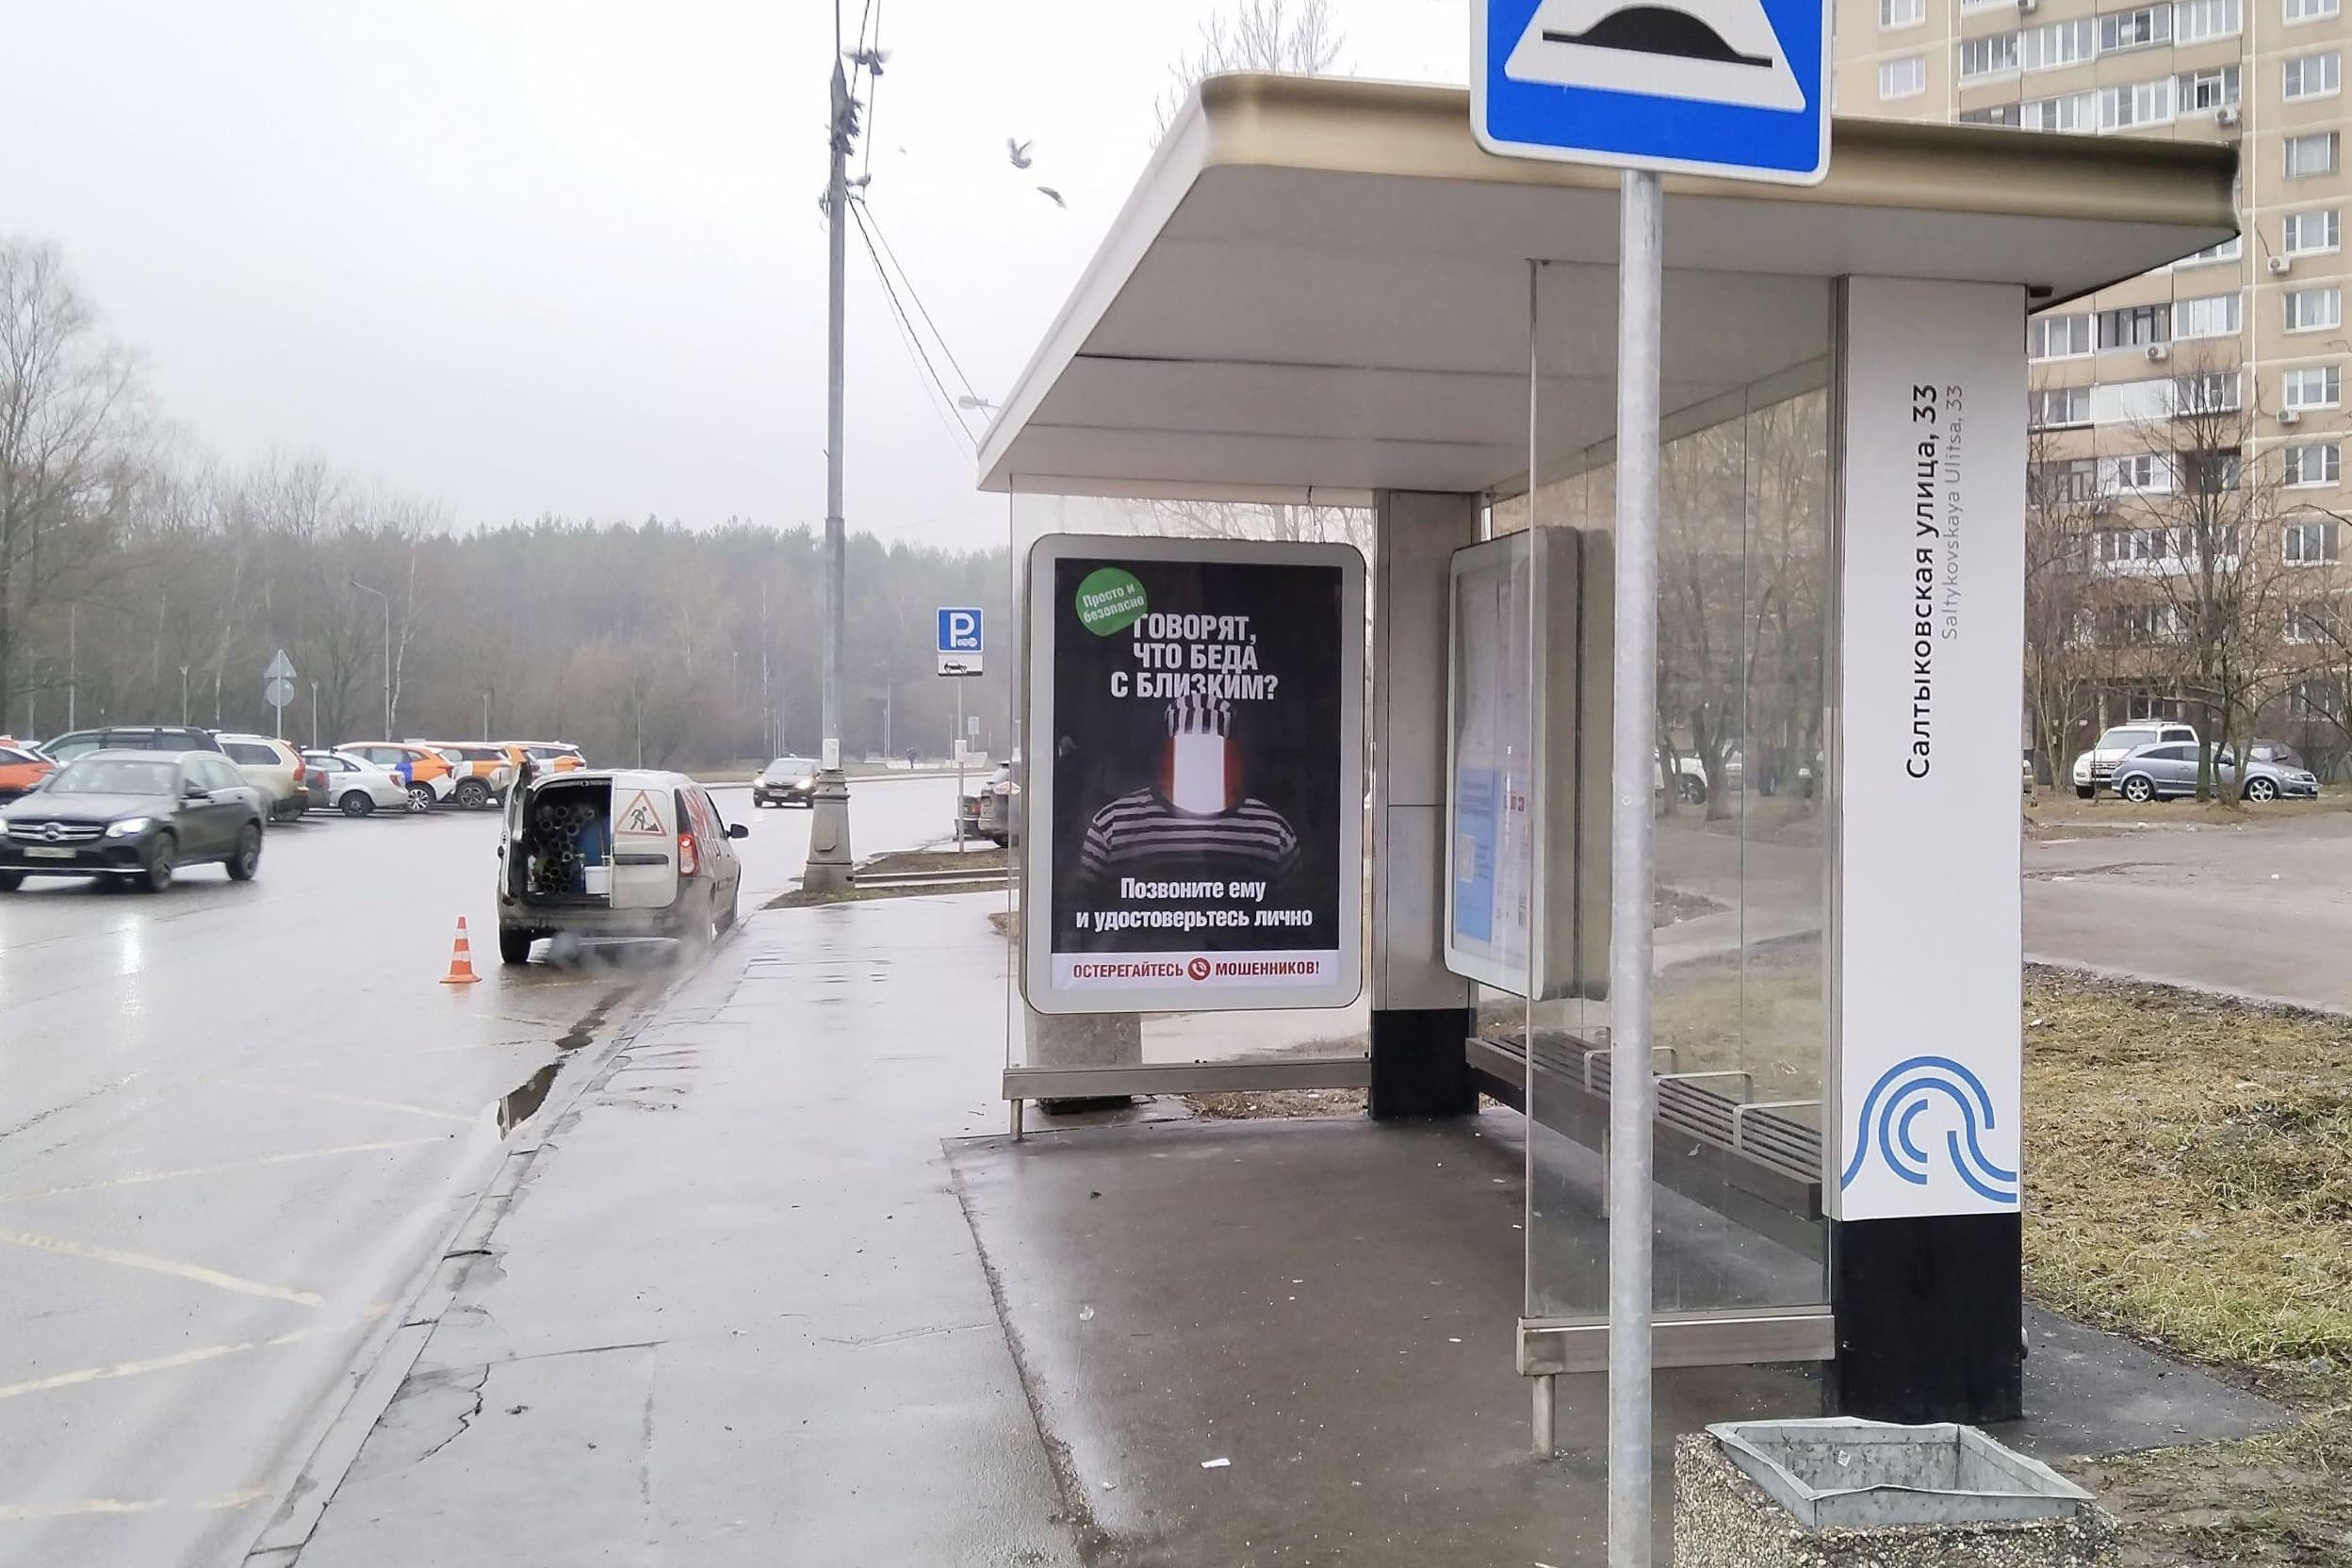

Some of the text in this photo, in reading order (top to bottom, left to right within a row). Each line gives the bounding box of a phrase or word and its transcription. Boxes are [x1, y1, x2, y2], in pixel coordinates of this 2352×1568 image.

[1941, 384, 1964, 640] Saltykovskaya Ulitsa, 33
[1083, 582, 1135, 609] Просто и
[1905, 384, 1940, 778] Салтыковская улица, 33
[1083, 595, 1145, 624] безопасно
[1133, 612, 1257, 645] ГОВОРЯТ,
[1133, 642, 1259, 675] ЧТО БЕДА
[1110, 671, 1279, 700] С БЛИЗКИМ?
[1120, 877, 1266, 903] Позвоните ему
[1076, 909, 1314, 932] и удостоверьтесь лично
[1072, 960, 1320, 978] ОСТЕРЕГАЙТЕСЬ МОШЕННИКОВ!
